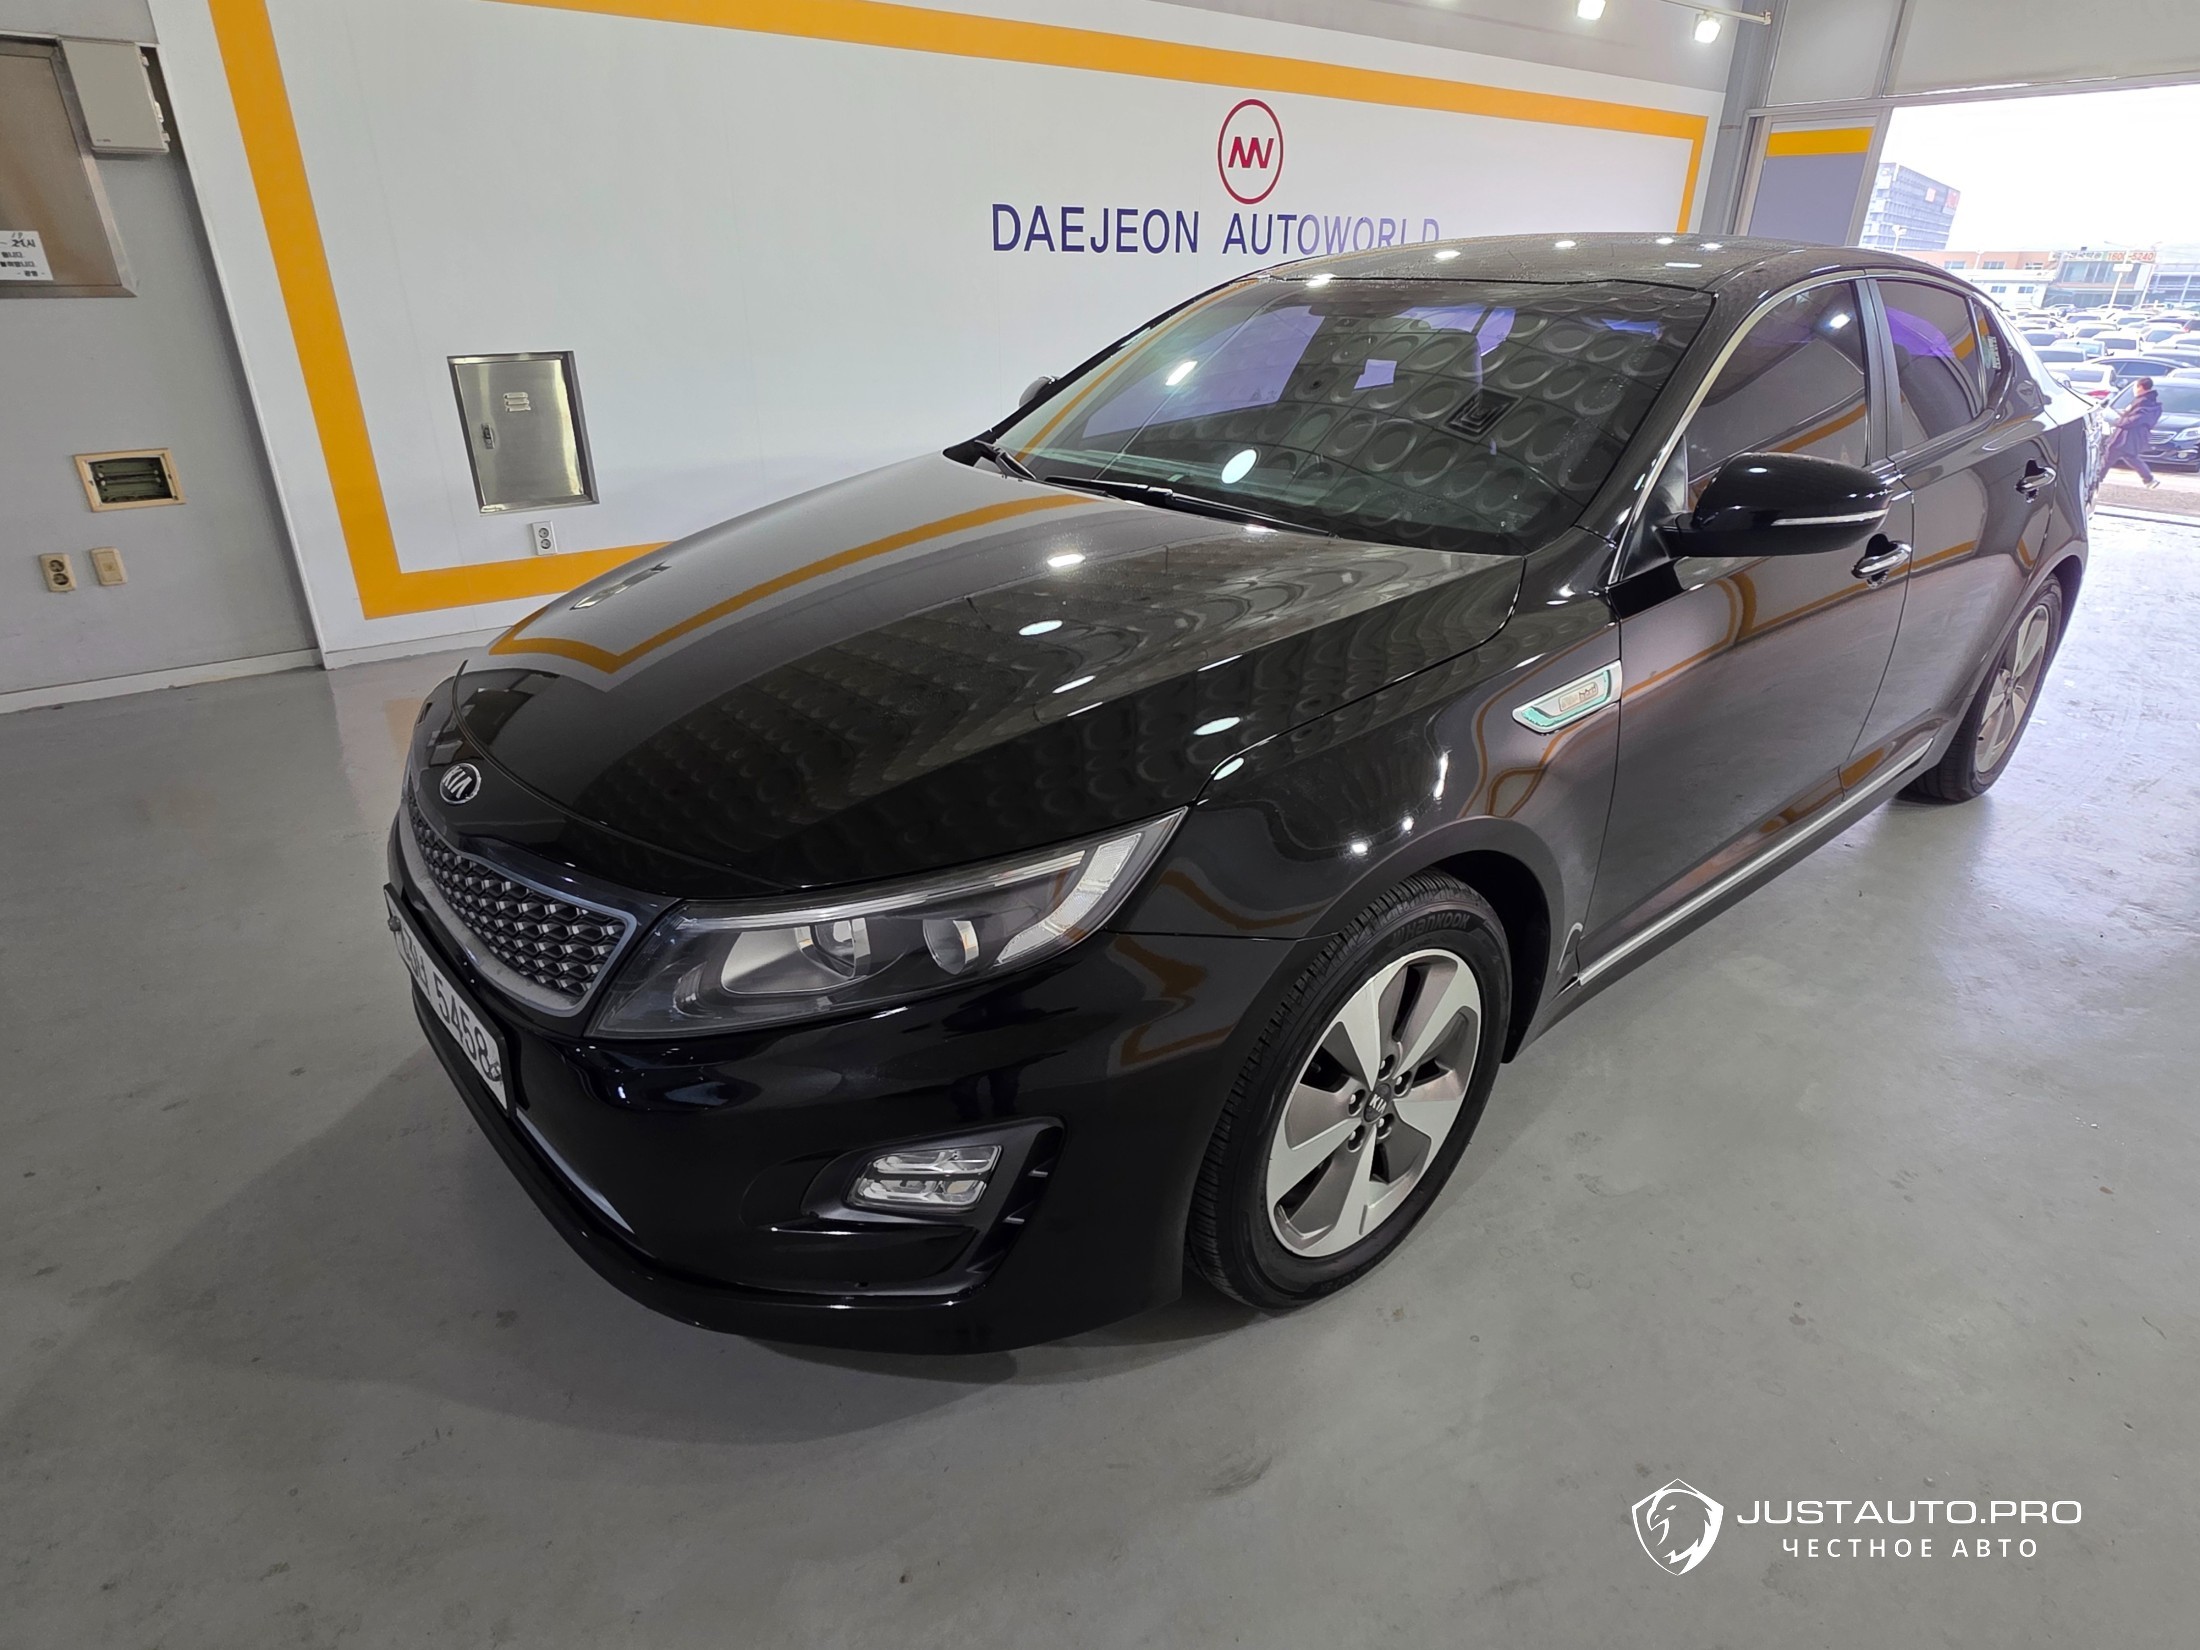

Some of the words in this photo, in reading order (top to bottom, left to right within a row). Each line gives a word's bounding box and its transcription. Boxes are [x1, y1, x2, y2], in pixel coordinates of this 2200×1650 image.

[992, 203, 1199, 254] DAEJEON
[442, 765, 473, 799] KIA
[433, 970, 499, 1082] 5458
[1369, 1093, 1387, 1114] KIA
